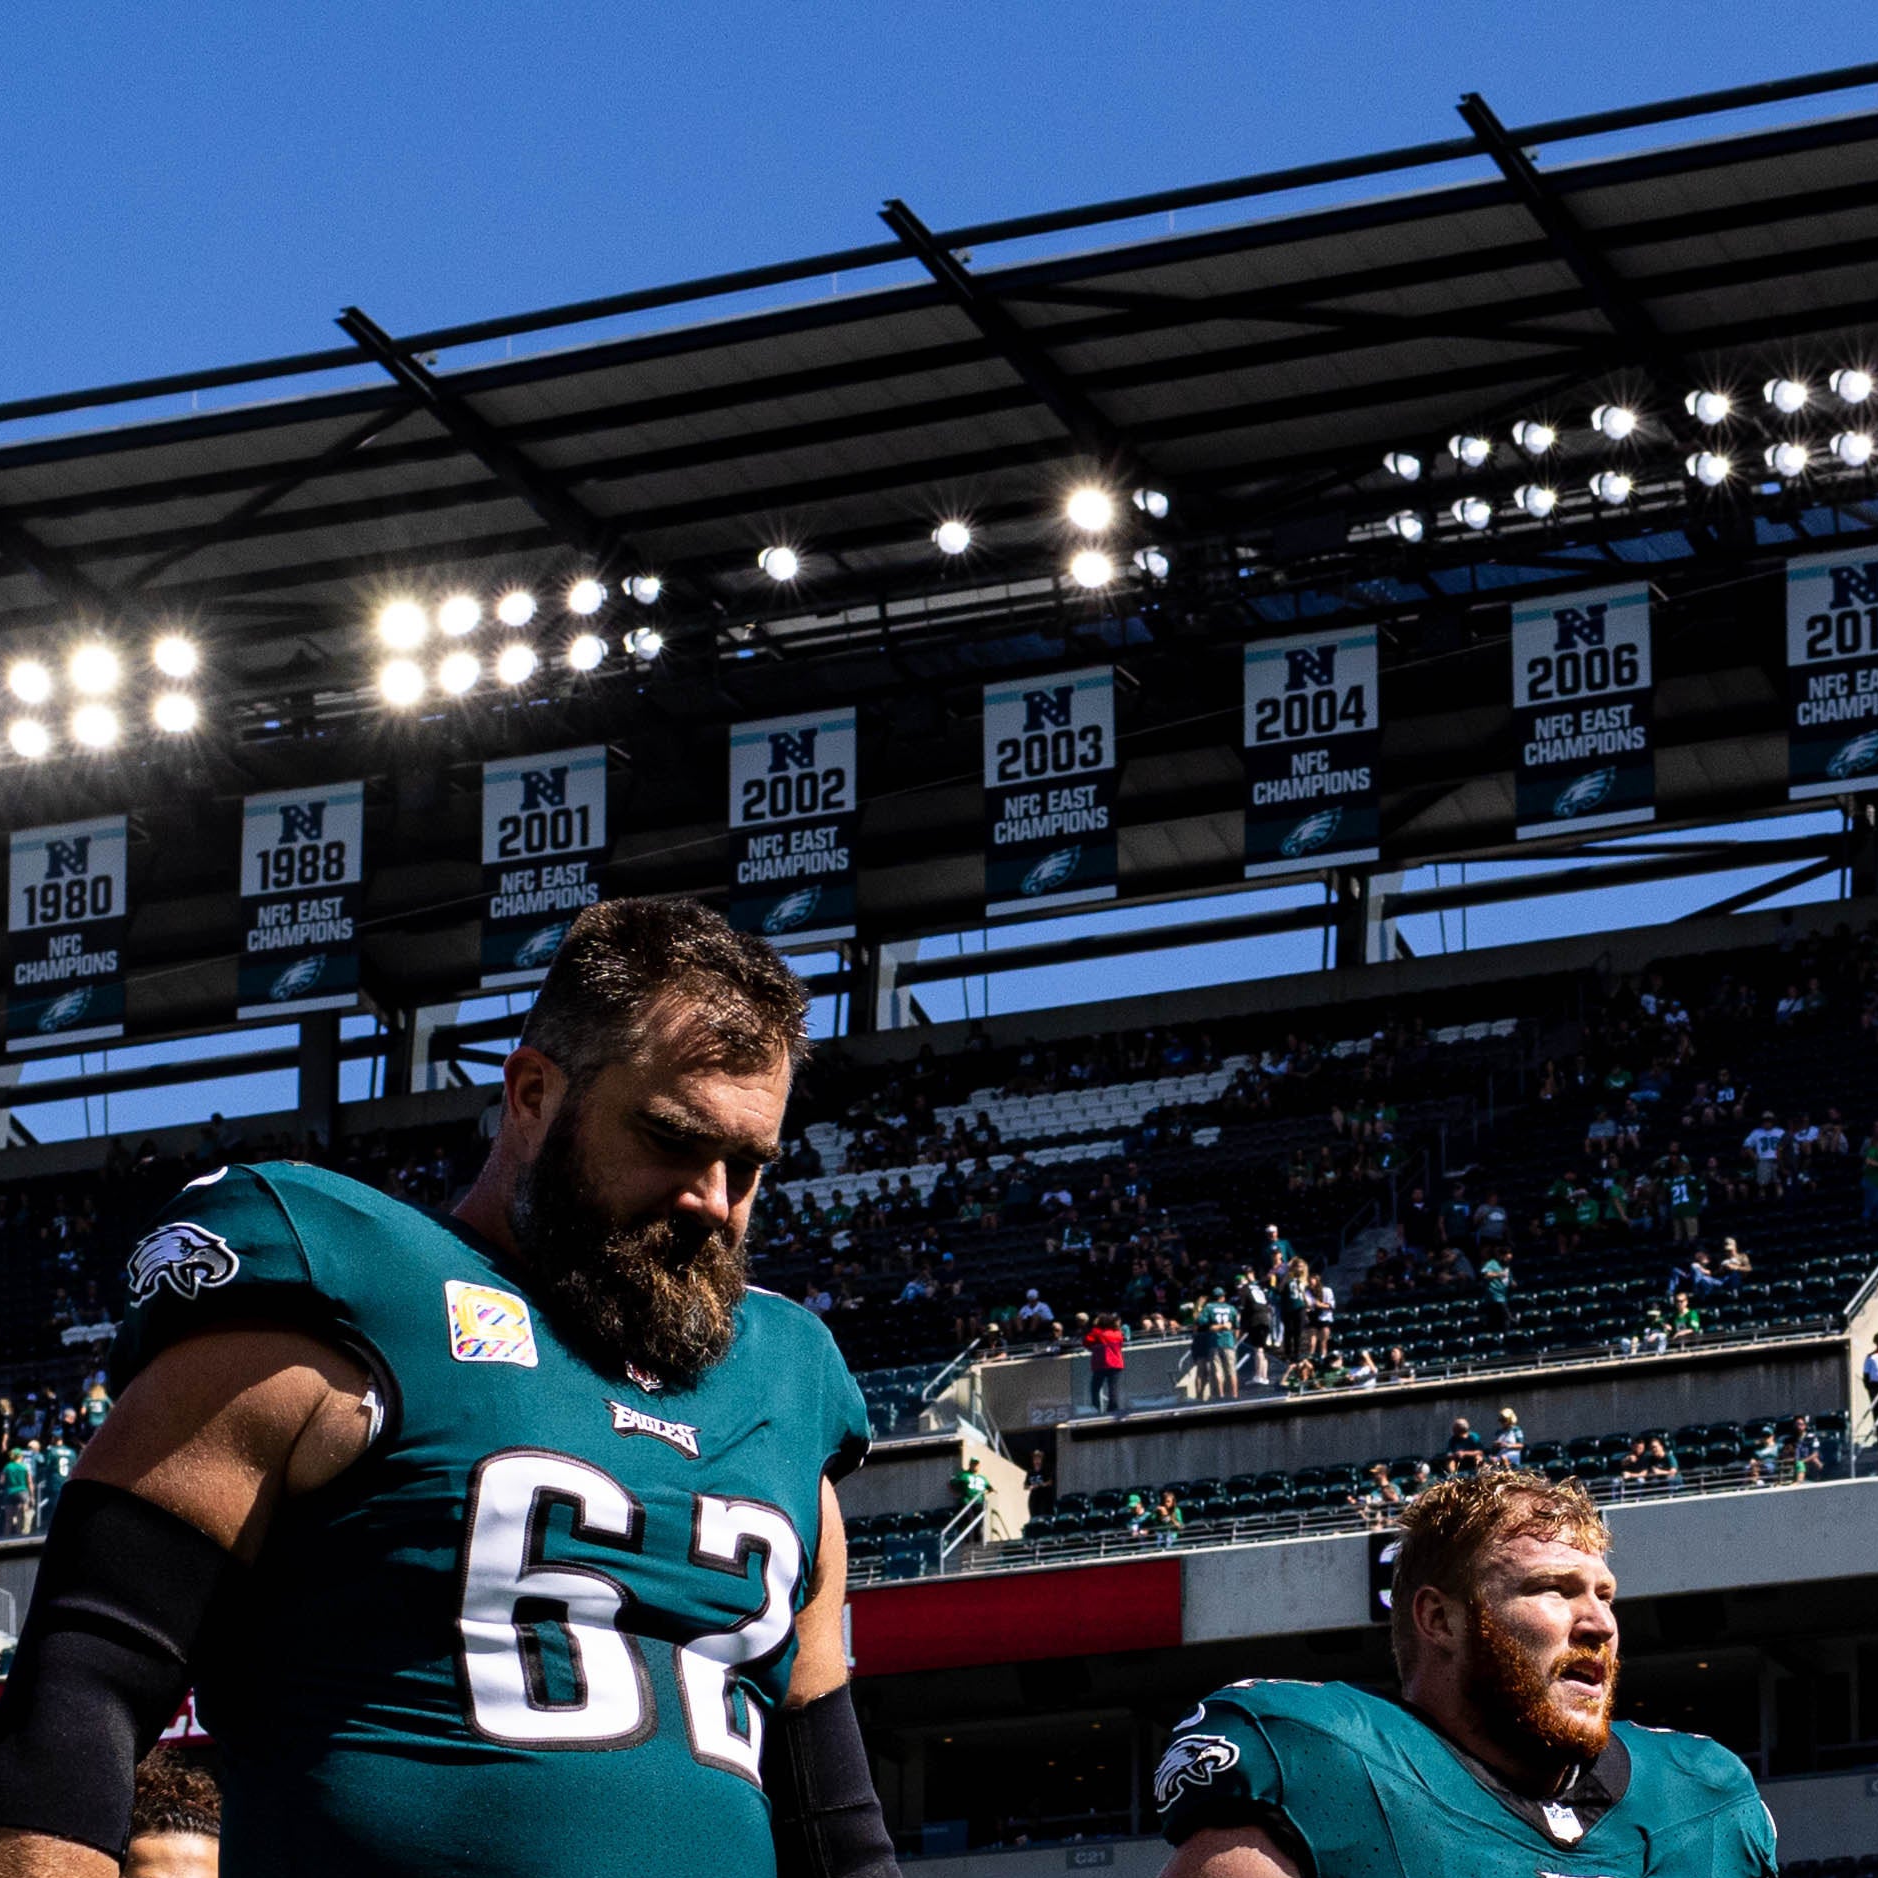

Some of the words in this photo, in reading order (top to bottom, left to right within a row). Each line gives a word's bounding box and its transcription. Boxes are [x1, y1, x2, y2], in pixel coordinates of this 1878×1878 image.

[1527, 644, 1638, 701] 2006
[1808, 673, 1849, 700] NFC
[1255, 685, 1366, 741] 2004
[1535, 714, 1574, 741] NFC
[1581, 704, 1634, 731] EAST
[997, 725, 1102, 781] 2003
[1290, 749, 1329, 775] NFC
[1523, 726, 1646, 766] CHAMPIONS
[742, 768, 846, 821] 2002
[1004, 794, 1042, 819] NFC
[1047, 785, 1098, 811] EAST
[1252, 767, 1371, 806] CHAMPIONS
[497, 805, 589, 859] 2001
[747, 832, 784, 858] NFC
[790, 826, 840, 851] EAST
[993, 805, 1109, 845] CHAMPIONS
[257, 842, 346, 891] 1988
[501, 869, 536, 894] NFC
[541, 862, 589, 885] EAST
[737, 847, 849, 885] CHAMPIONS
[23, 875, 112, 926] 1980
[257, 903, 292, 929] NFC
[295, 896, 345, 922] EAST
[490, 883, 598, 920] CHAMPIONS
[48, 933, 83, 958] NFC
[246, 918, 354, 954] CHAMPIONS
[14, 950, 119, 986] CHAMPIONS
[1672, 1184, 1690, 1205] 21
[456, 1289, 529, 1341] C
[601, 1399, 702, 1459] EAGLES
[458, 1447, 804, 1791] 62
[1074, 1852, 1107, 1864] C21
